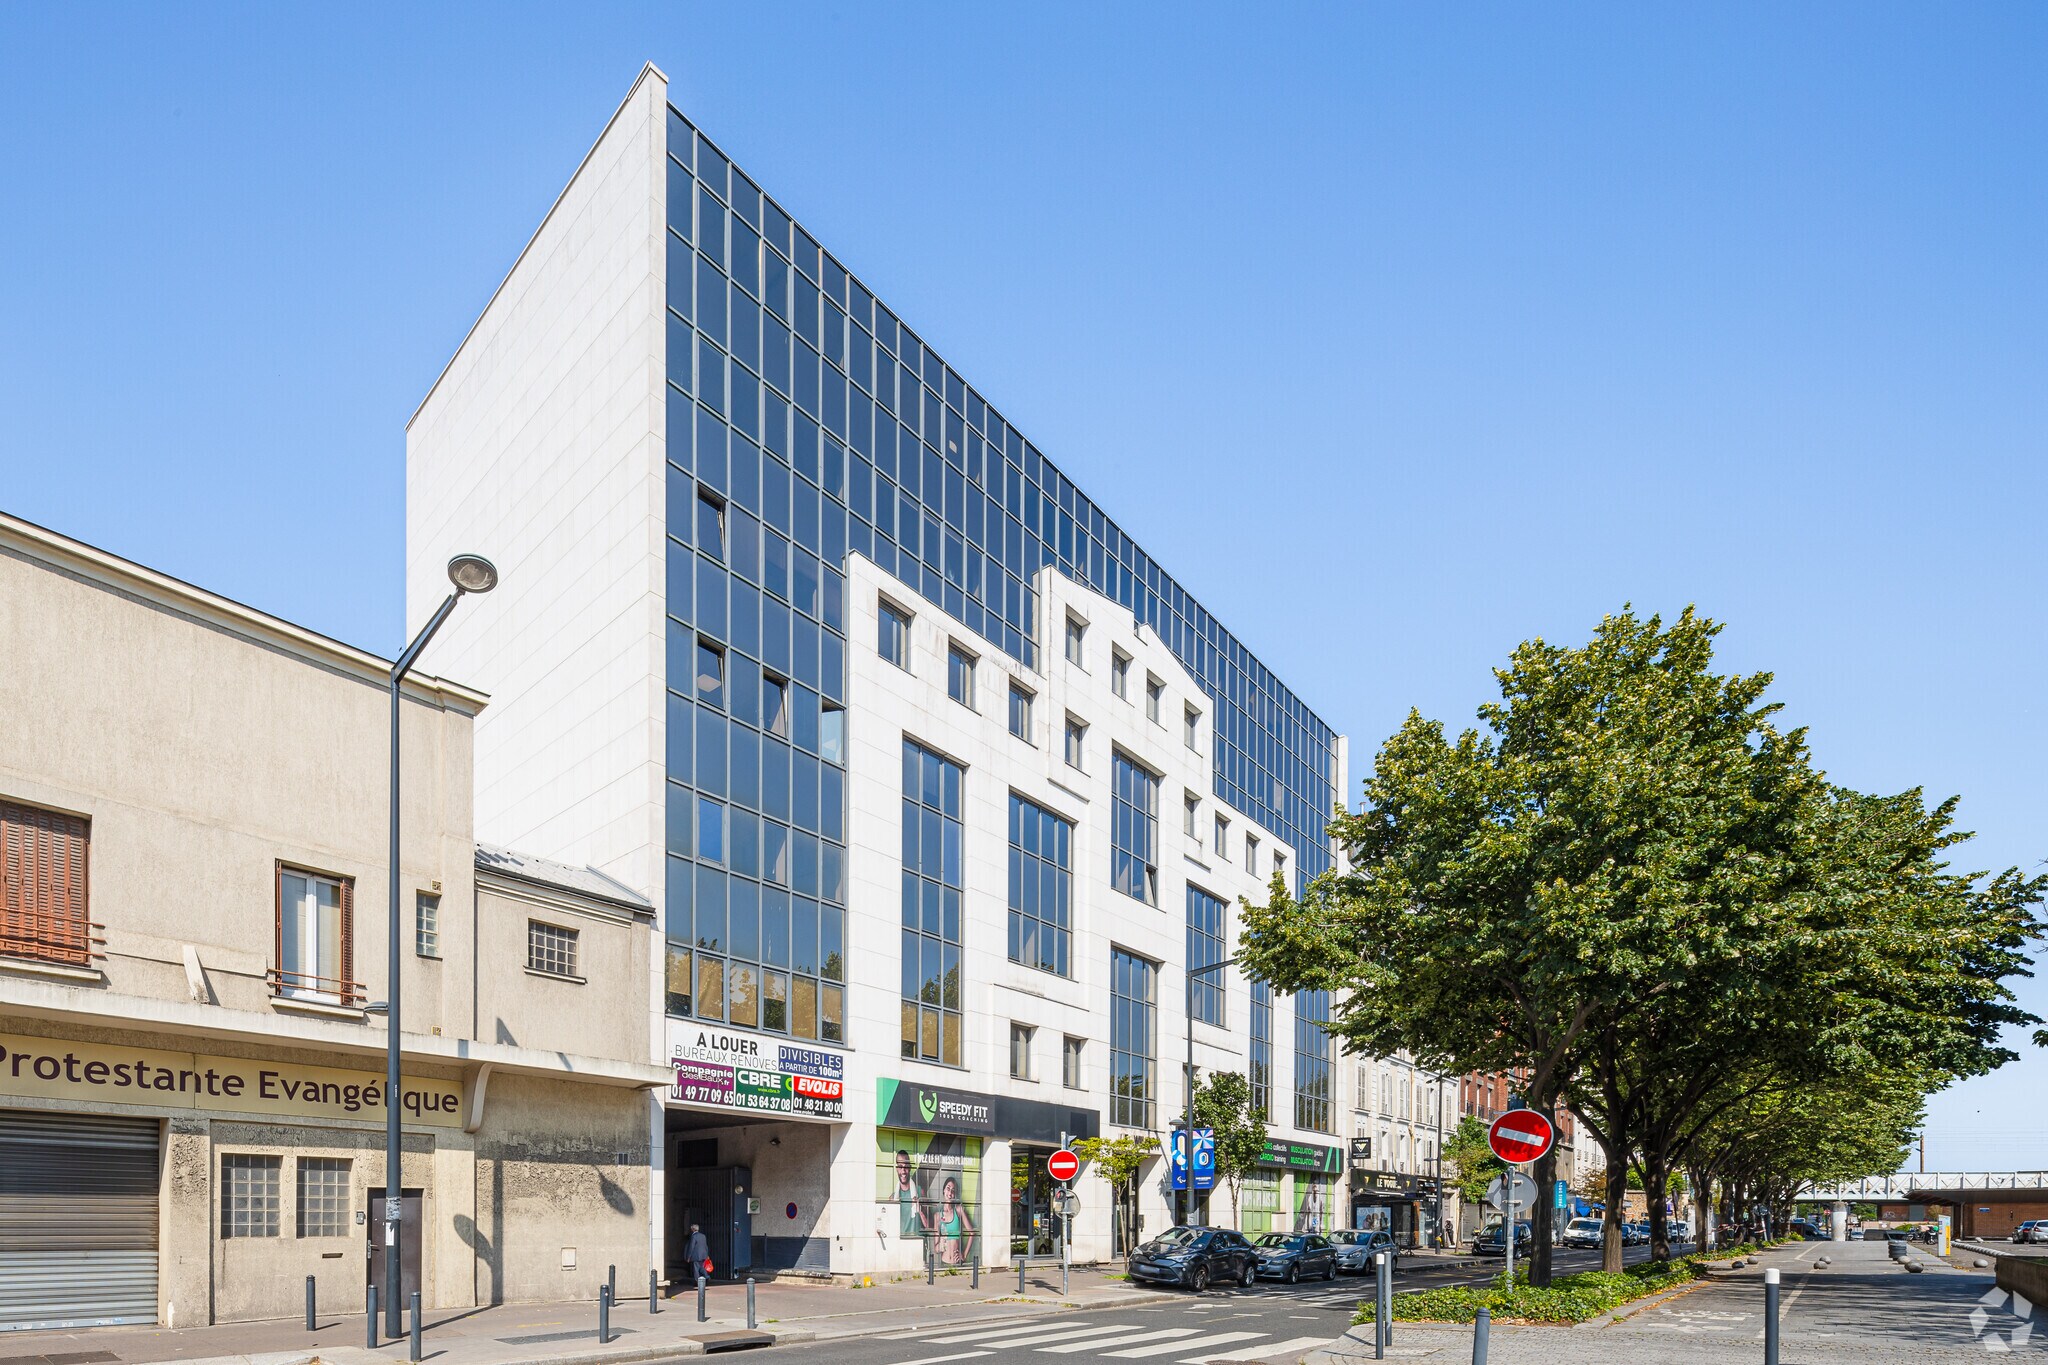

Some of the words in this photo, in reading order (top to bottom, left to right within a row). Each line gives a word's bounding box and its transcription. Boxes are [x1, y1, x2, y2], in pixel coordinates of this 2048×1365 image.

[697, 1032, 706, 1047] A
[712, 1034, 758, 1056] LOUER
[676, 1045, 727, 1063] BUREAUX
[731, 1054, 777, 1071] RENOVES
[780, 1047, 841, 1068] DIVISIBLES
[0, 1045, 244, 1096] rotestante
[673, 1062, 733, 1079] Compagnie
[786, 1063, 807, 1073] PARTIR
[809, 1066, 817, 1074] DE
[738, 1071, 781, 1089] CBRE
[798, 1078, 840, 1096] EVOLIS
[672, 1085, 682, 1098] 01
[686, 1086, 696, 1099] 49
[699, 1087, 709, 1101] 77
[711, 1089, 722, 1102] 09
[724, 1091, 733, 1104] 65
[737, 1093, 745, 1105] 01
[748, 1095, 757, 1107] 53
[759, 1096, 768, 1108] 64
[770, 1097, 780, 1109] 37
[781, 1098, 790, 1111] 08
[794, 1097, 802, 1109] 01
[805, 1099, 813, 1110] 48
[815, 1100, 822, 1111] 21
[825, 1102, 833, 1112] 80
[835, 1103, 842, 1114] 00
[940, 1101, 972, 1116] SPEEDY
[974, 1106, 988, 1118] FIT
[958, 1115, 988, 1123] COACHING
[1377, 1178, 1382, 1187] LE
